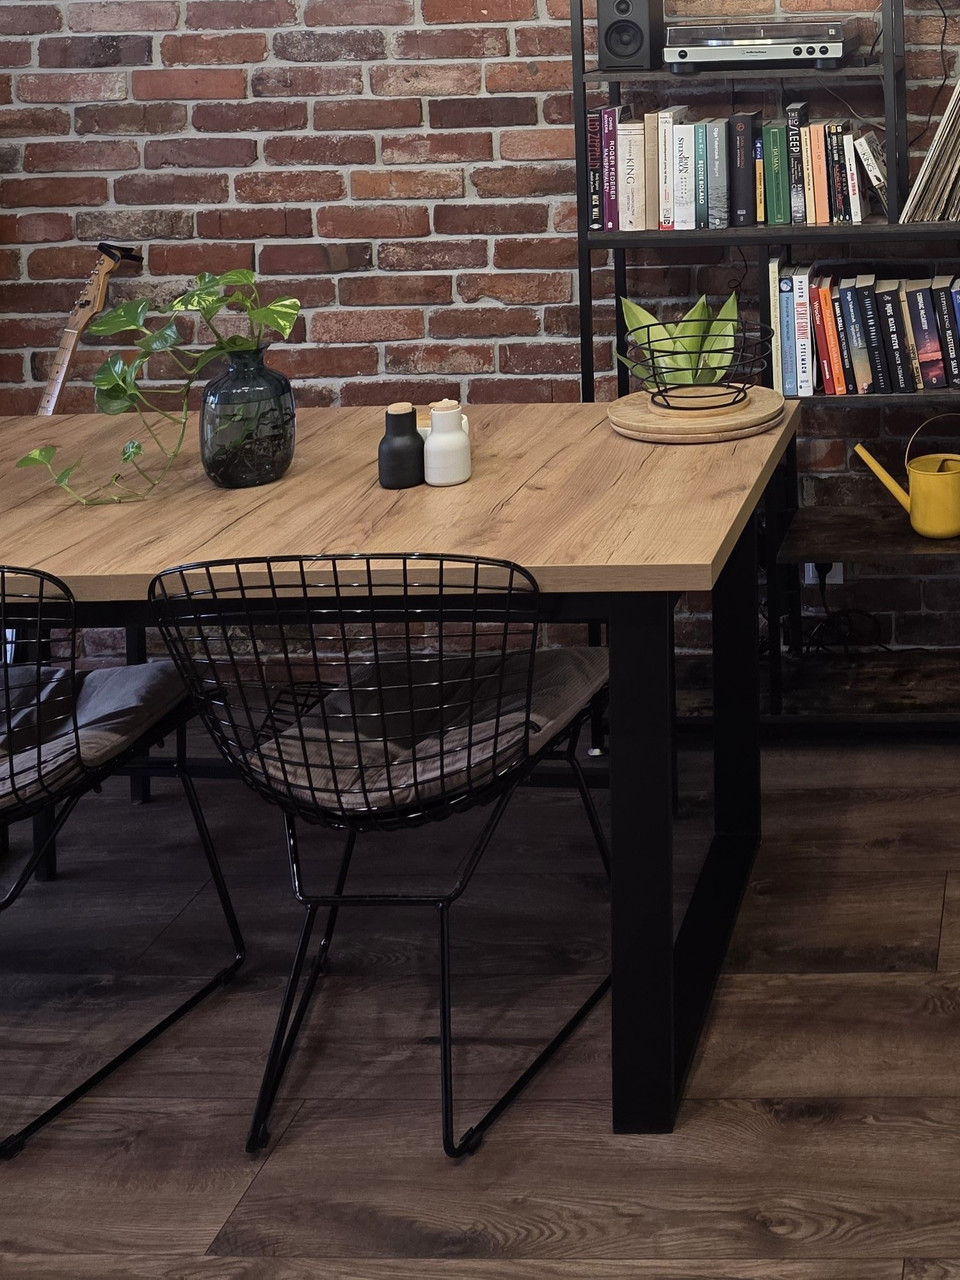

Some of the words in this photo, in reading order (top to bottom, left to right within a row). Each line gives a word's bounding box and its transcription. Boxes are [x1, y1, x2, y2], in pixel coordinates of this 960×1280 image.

[588, 118, 599, 131] LED
[789, 126, 799, 153] SLEEP
[588, 134, 600, 168] ZEPPELIN
[626, 158, 634, 184] KING
[860, 152, 873, 173] KING
[813, 301, 821, 325] Wrocław
[848, 301, 856, 323] Tokarczuk
[940, 292, 948, 314] STEPHEN
[891, 334, 899, 349] BAZAR
[896, 366, 905, 388] STEPHEN
